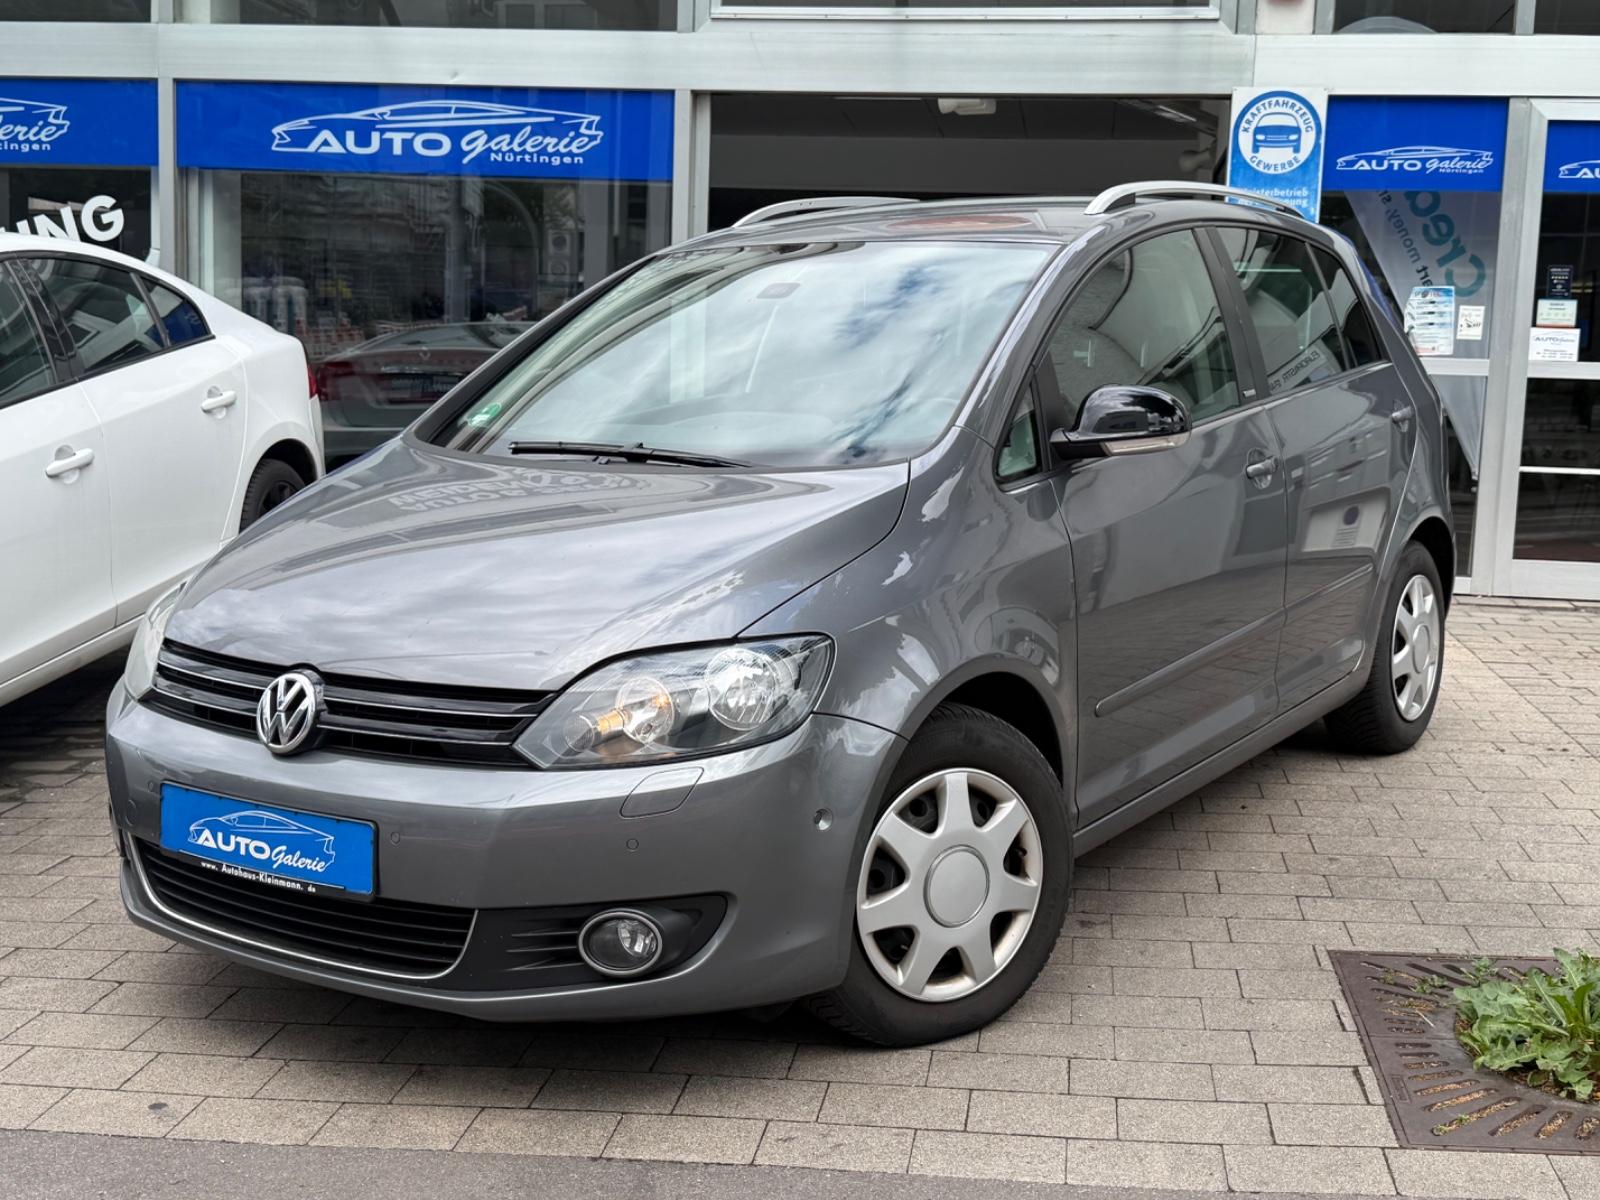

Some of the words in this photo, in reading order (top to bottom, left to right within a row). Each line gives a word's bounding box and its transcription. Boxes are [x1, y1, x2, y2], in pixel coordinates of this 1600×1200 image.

[0, 115, 57, 142] erie
[1242, 99, 1313, 133] KRAFTFAHRZEUG
[308, 128, 451, 157] AUTO
[461, 125, 592, 164] galerie
[490, 153, 584, 165] Nürtingen
[1249, 154, 1301, 172] GEWERBE
[1354, 159, 1422, 171] AUTO
[1426, 157, 1488, 174] galerie
[196, 828, 271, 859] AUTO
[271, 845, 327, 872] Galerie
